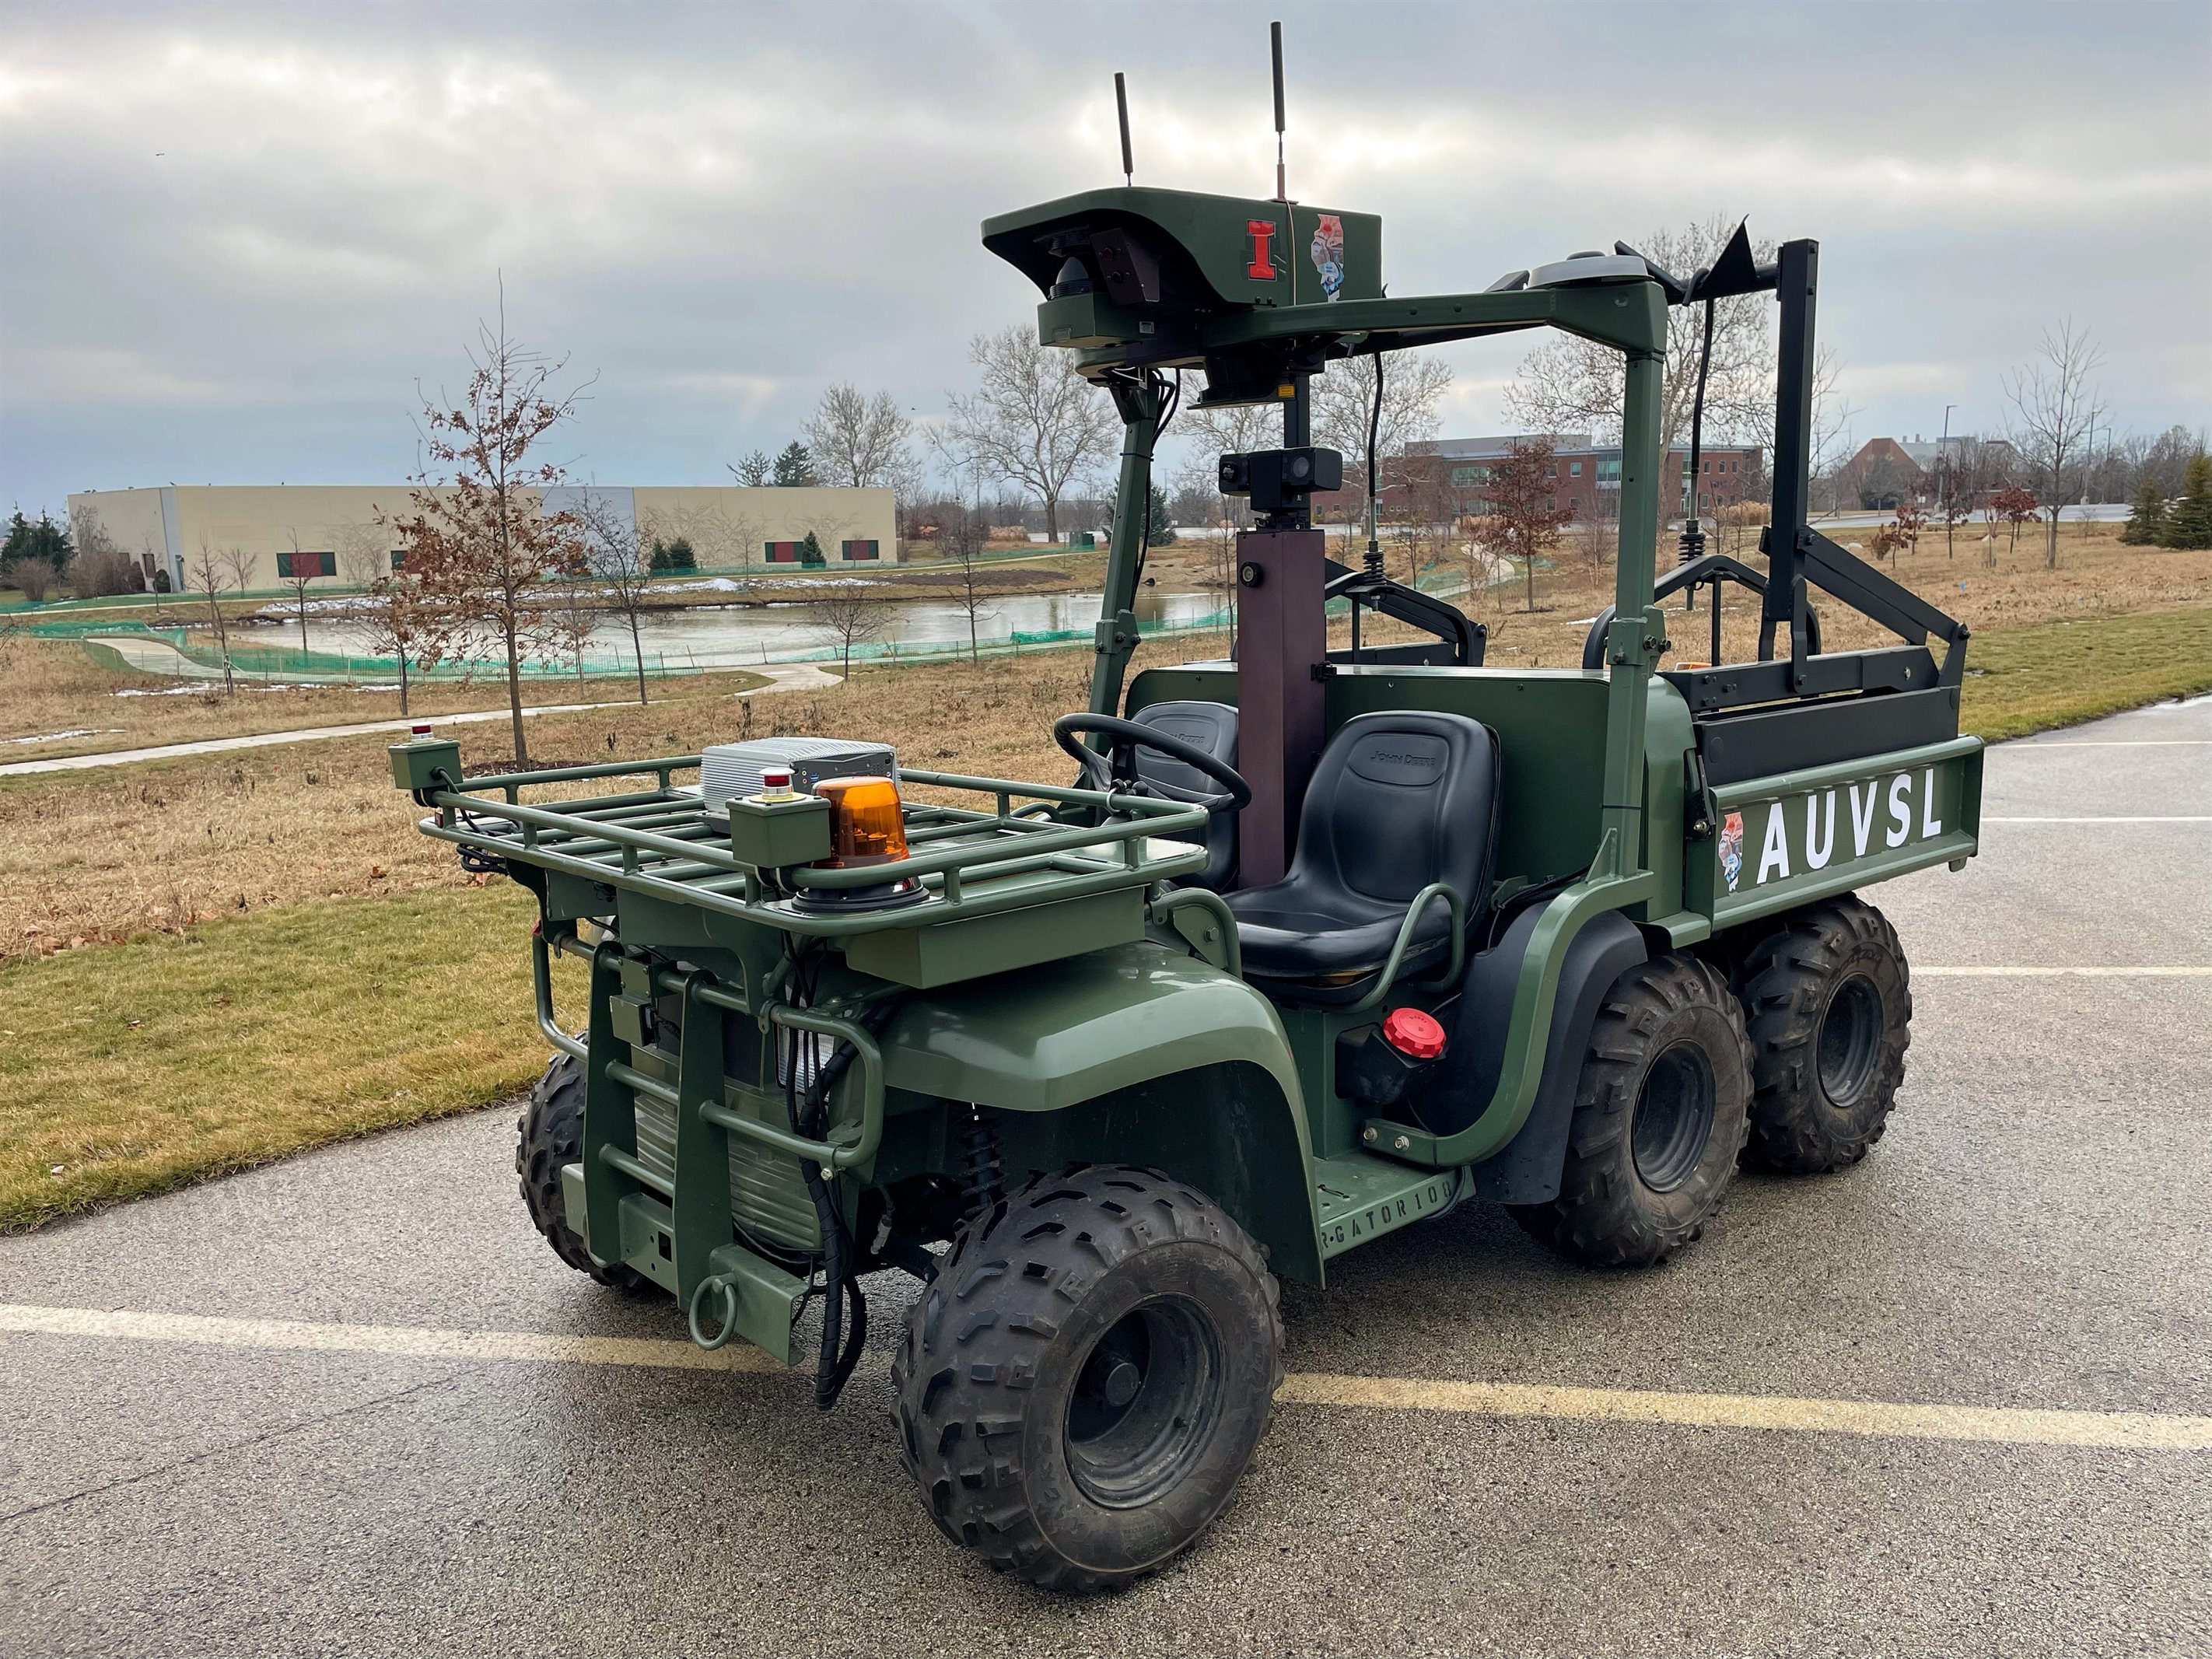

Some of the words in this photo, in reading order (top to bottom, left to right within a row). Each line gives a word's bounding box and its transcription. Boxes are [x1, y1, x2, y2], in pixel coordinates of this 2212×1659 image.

[1247, 219, 1277, 282] I
[1370, 751, 1403, 765] JOHN
[1404, 754, 1437, 767] DEERE
[1756, 768, 1943, 884] AUVSL
